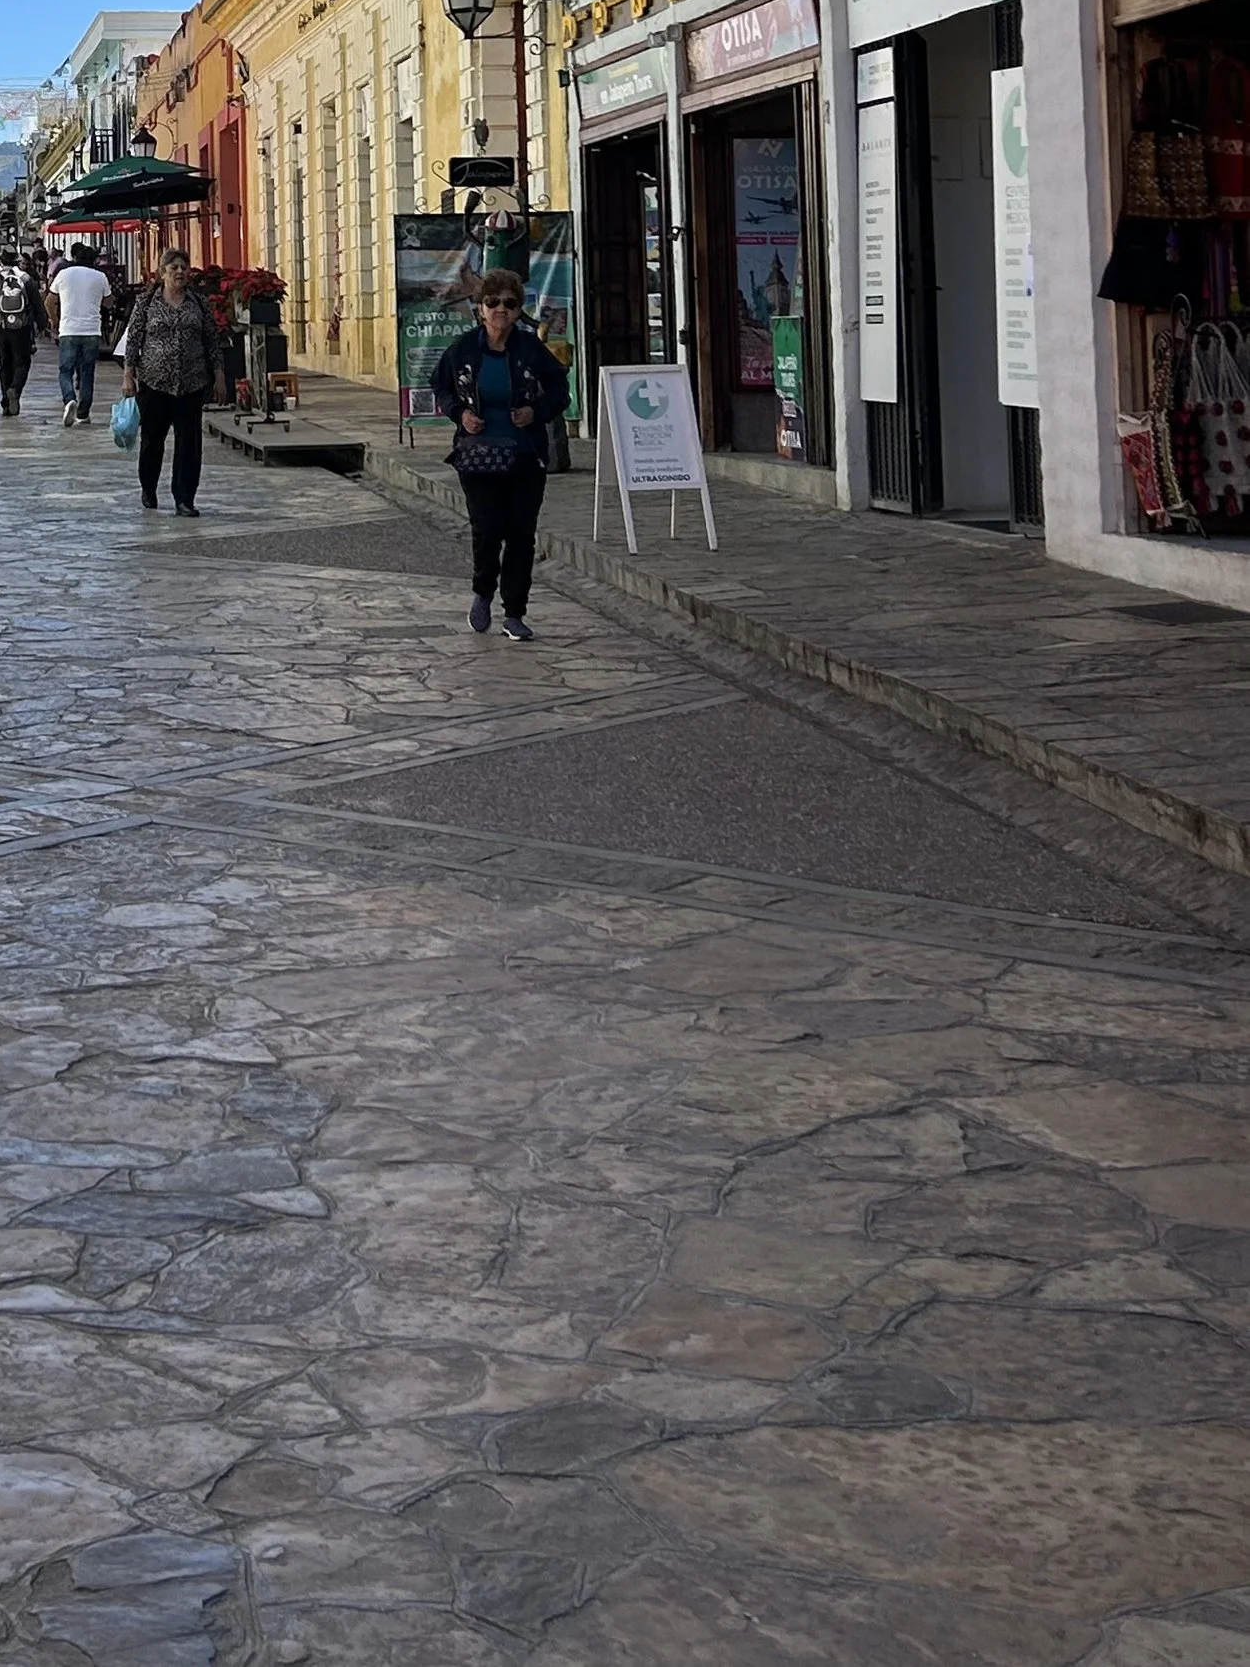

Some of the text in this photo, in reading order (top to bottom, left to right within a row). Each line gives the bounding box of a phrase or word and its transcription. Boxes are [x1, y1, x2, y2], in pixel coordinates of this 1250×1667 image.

[721, 10, 763, 52] OTISA
[737, 175, 796, 189] OTISA
[632, 474, 691, 483] ULTRASONIDO
